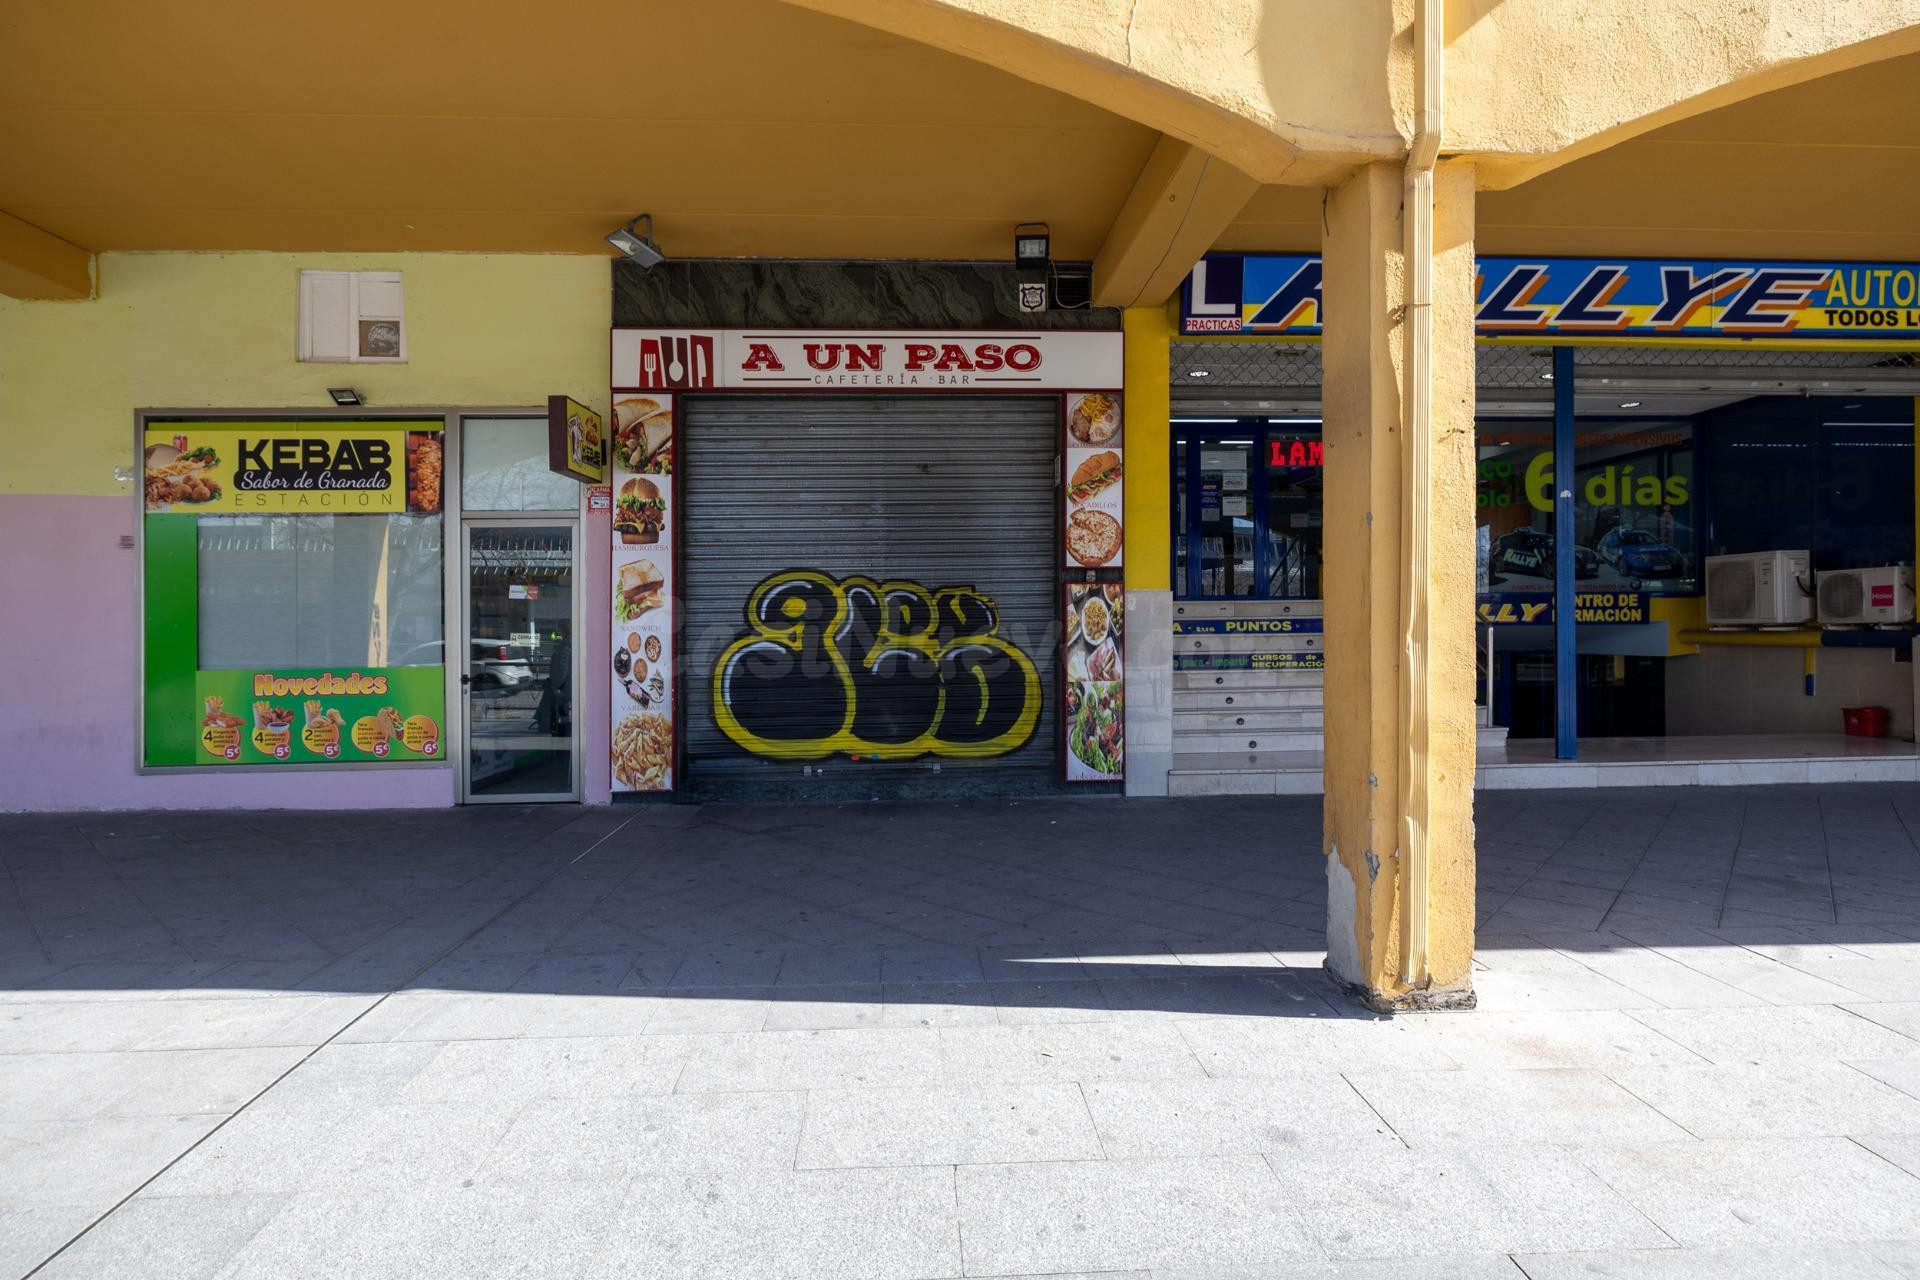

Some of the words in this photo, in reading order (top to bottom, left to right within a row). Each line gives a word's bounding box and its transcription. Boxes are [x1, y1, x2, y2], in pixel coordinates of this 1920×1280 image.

[1825, 269, 1920, 307] AUTO
[1185, 319, 1241, 330] PRACTICAS
[1825, 309, 1899, 327] TODOS
[1907, 310, 1920, 326] L
[741, 343, 785, 372] A
[803, 343, 887, 372] UN
[904, 343, 1043, 372] PASO
[814, 372, 919, 385] CAFETERÍA
[938, 375, 971, 385] BAR
[238, 438, 393, 471] KEBAB
[240, 470, 290, 490] Sabor
[293, 471, 315, 490] de
[317, 470, 390, 490] Granada
[1584, 464, 1690, 506] días
[234, 491, 393, 507] ESTACIÓN
[1617, 594, 1639, 607] DE
[1476, 602, 1549, 623] LLY
[1552, 607, 1642, 623] RMACIÓN
[1196, 625, 1216, 633] tus
[1225, 620, 1293, 632] PUNTOS
[1251, 660, 1325, 668] RECUPERACIÓ
[253, 671, 389, 697] Novedades
[204, 730, 213, 742] 4
[254, 731, 264, 744] 4
[304, 729, 313, 741] 2
